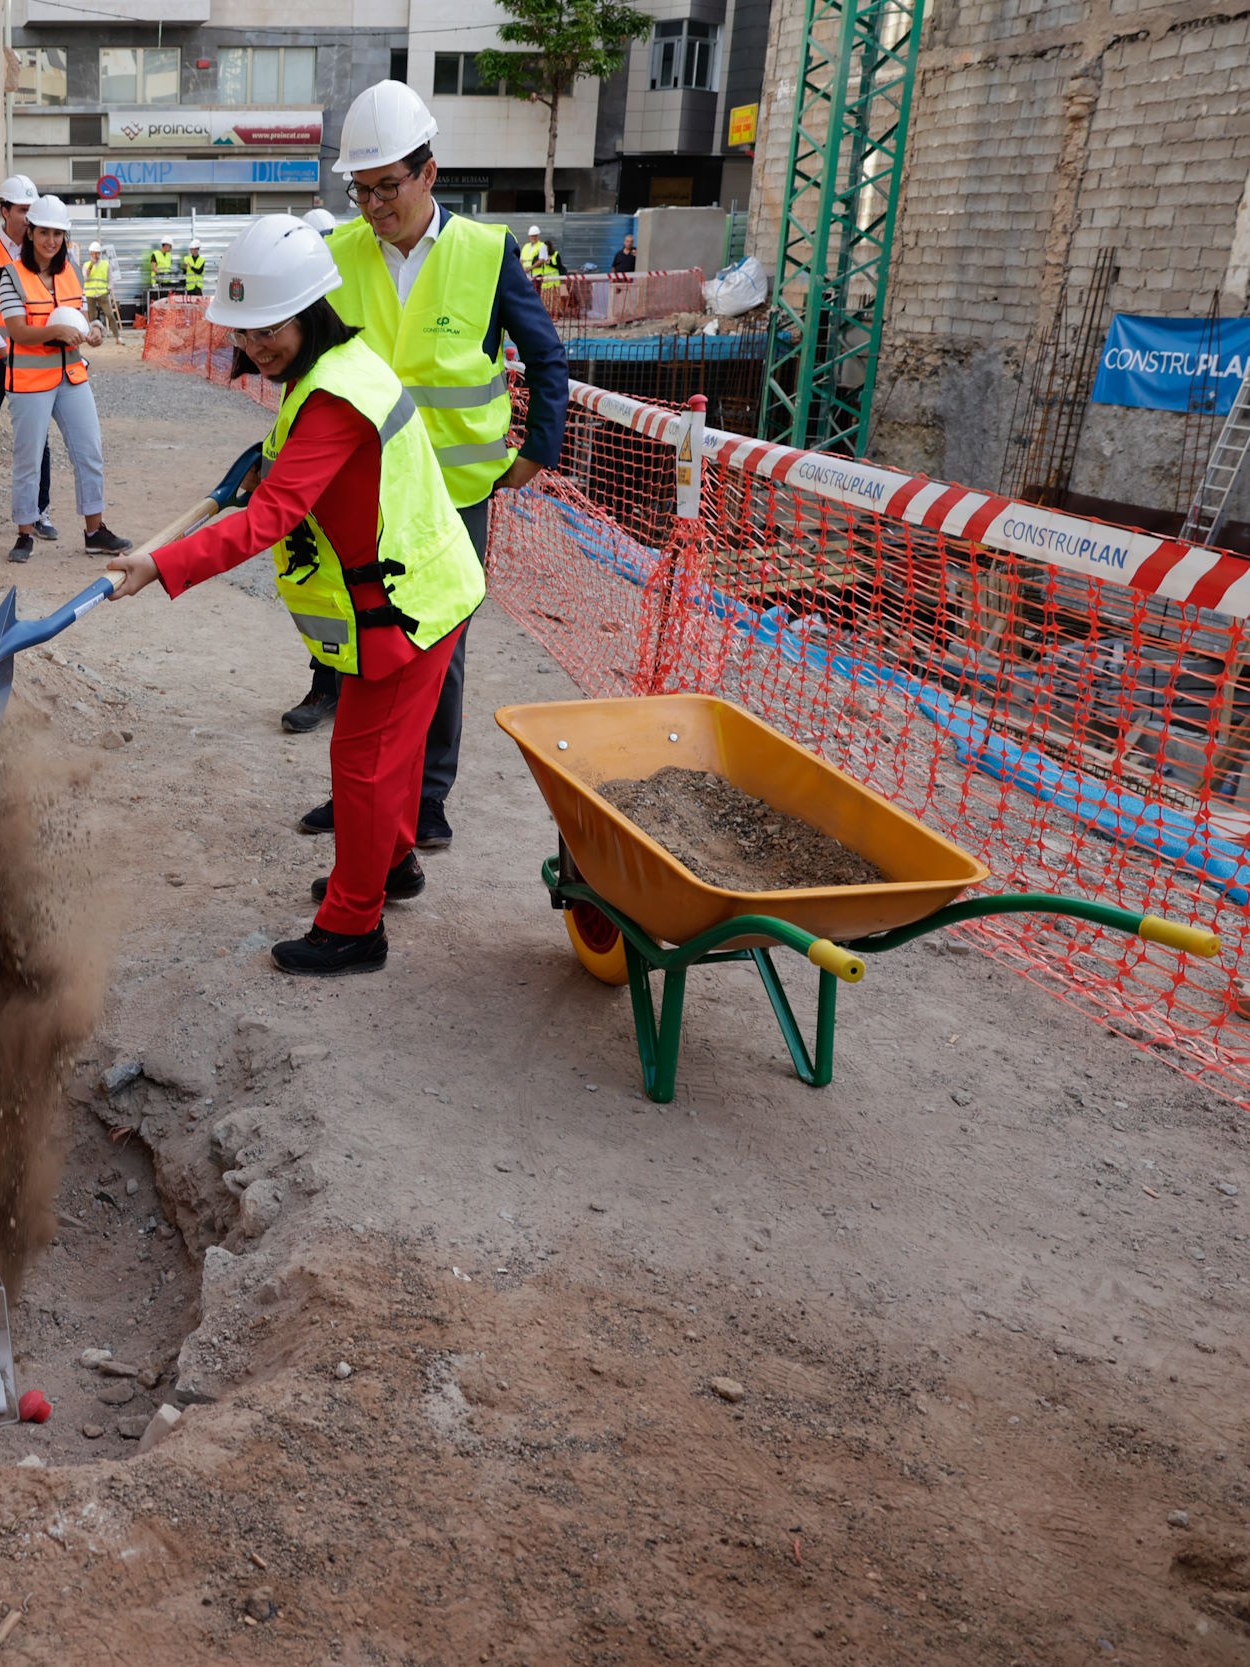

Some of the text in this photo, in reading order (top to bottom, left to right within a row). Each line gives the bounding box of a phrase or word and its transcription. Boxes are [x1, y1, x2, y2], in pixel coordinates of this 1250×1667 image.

[252, 131, 310, 140] www.proincat.com
[115, 161, 173, 183] ACMP
[799, 462, 885, 500] CONSTRUPLAN
[1003, 519, 1129, 569] CONSTRUPLAN
